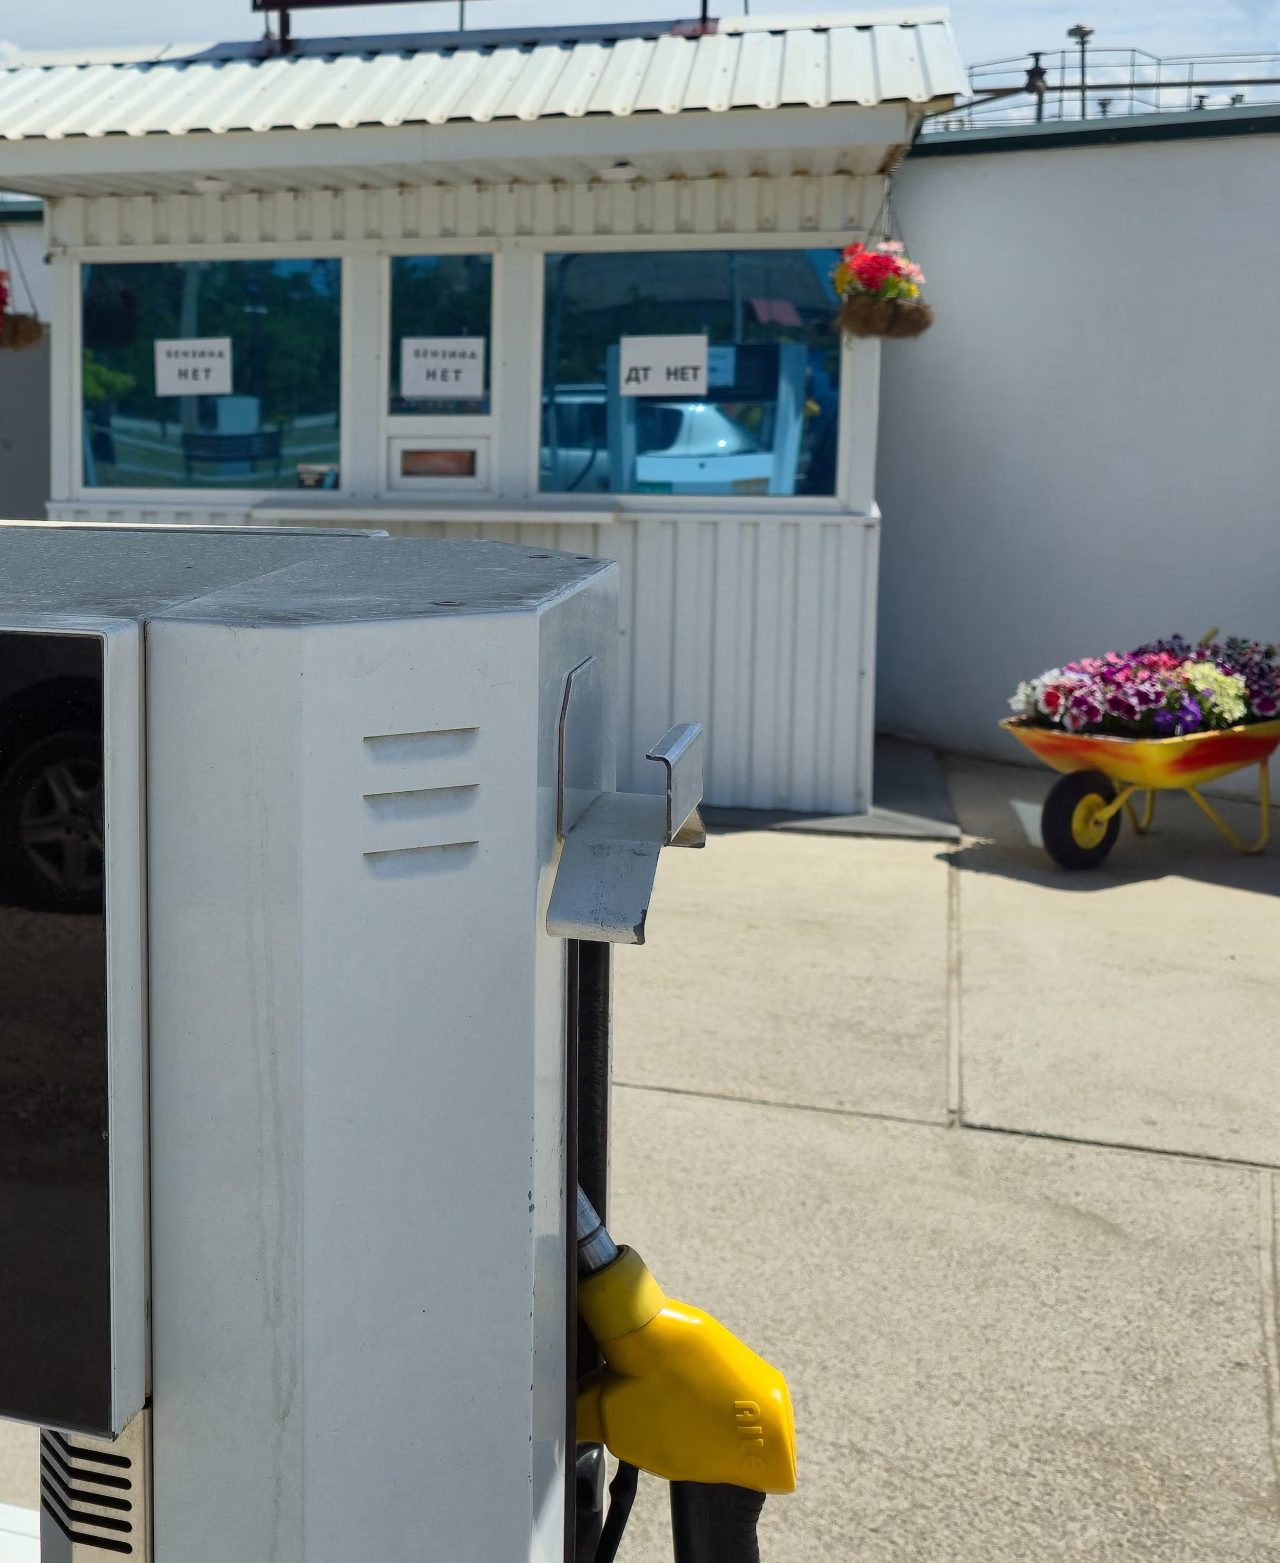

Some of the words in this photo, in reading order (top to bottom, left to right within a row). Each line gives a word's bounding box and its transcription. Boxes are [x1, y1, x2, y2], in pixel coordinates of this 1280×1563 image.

[177, 367, 212, 381] НЕТ
[425, 367, 463, 382] НЕТ
[625, 366, 651, 385] ДТ
[665, 365, 701, 382] НЕТ
